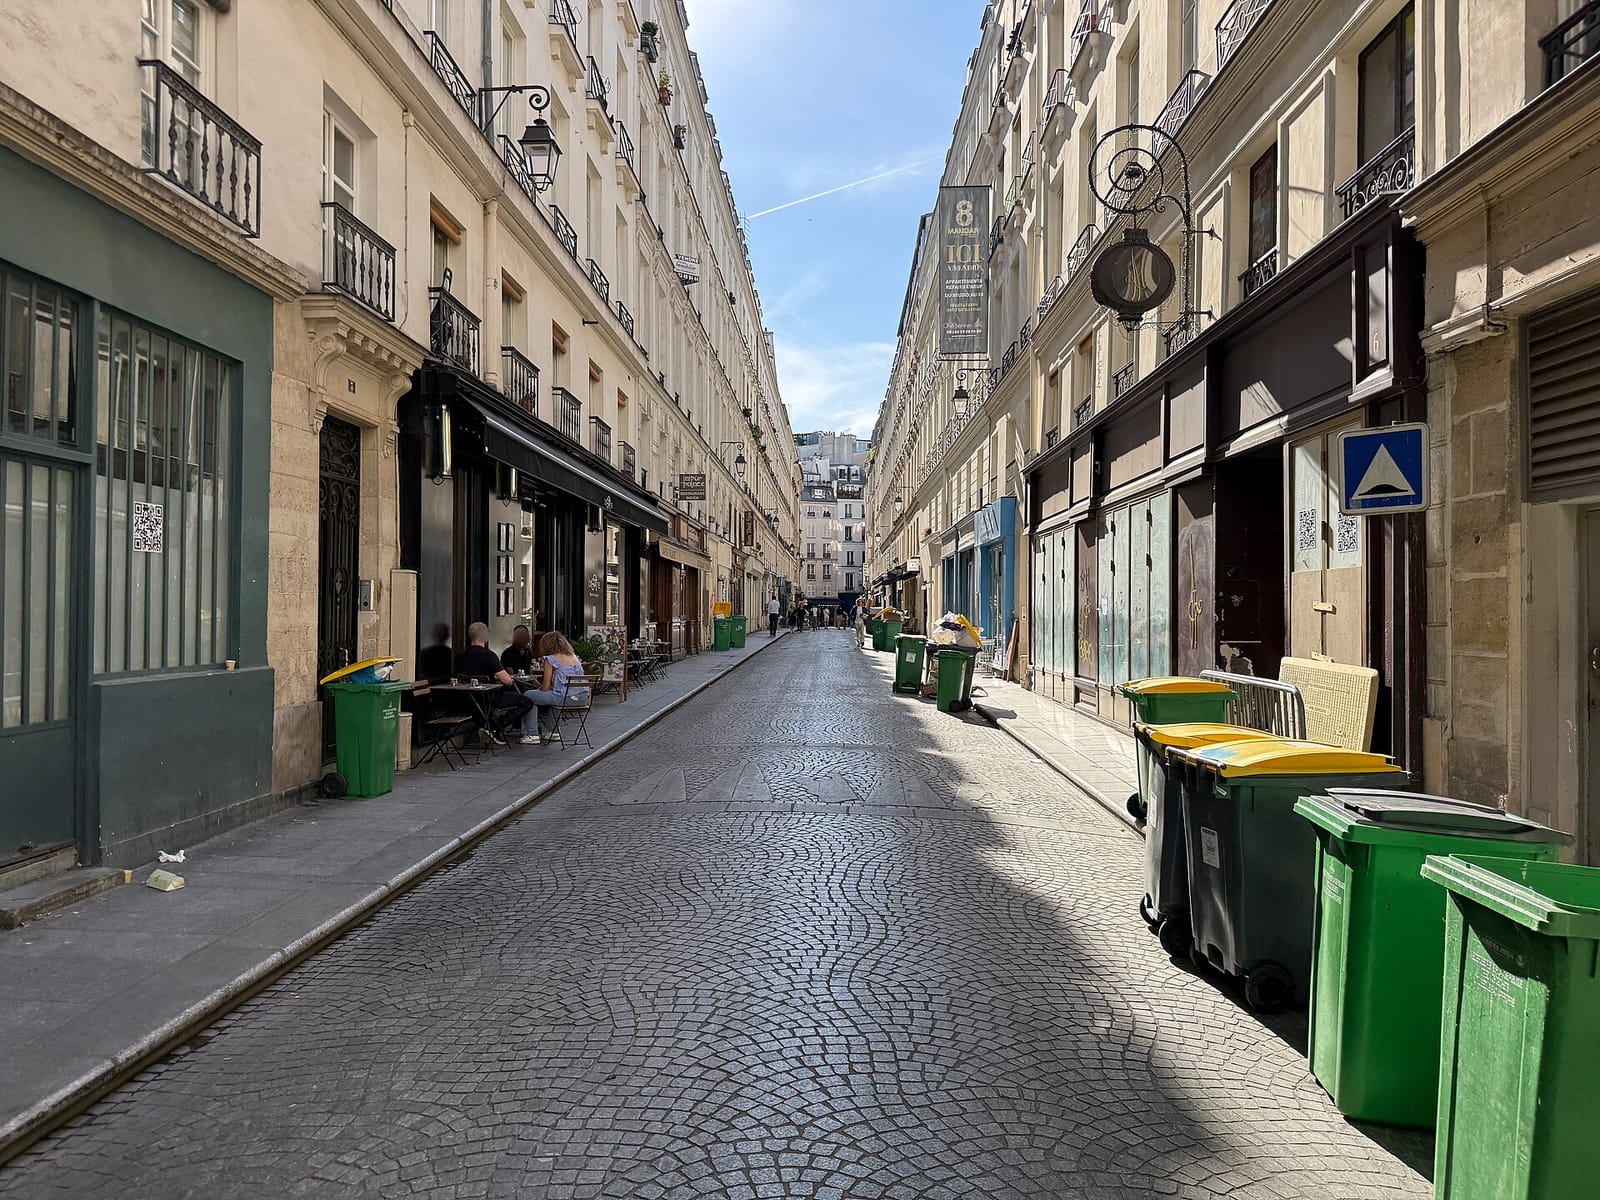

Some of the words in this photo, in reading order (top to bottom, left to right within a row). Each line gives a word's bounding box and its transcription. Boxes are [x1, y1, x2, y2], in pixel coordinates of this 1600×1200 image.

[956, 200, 973, 226] 8
[947, 227, 979, 235] MANDAR
[946, 244, 981, 264] ICI
